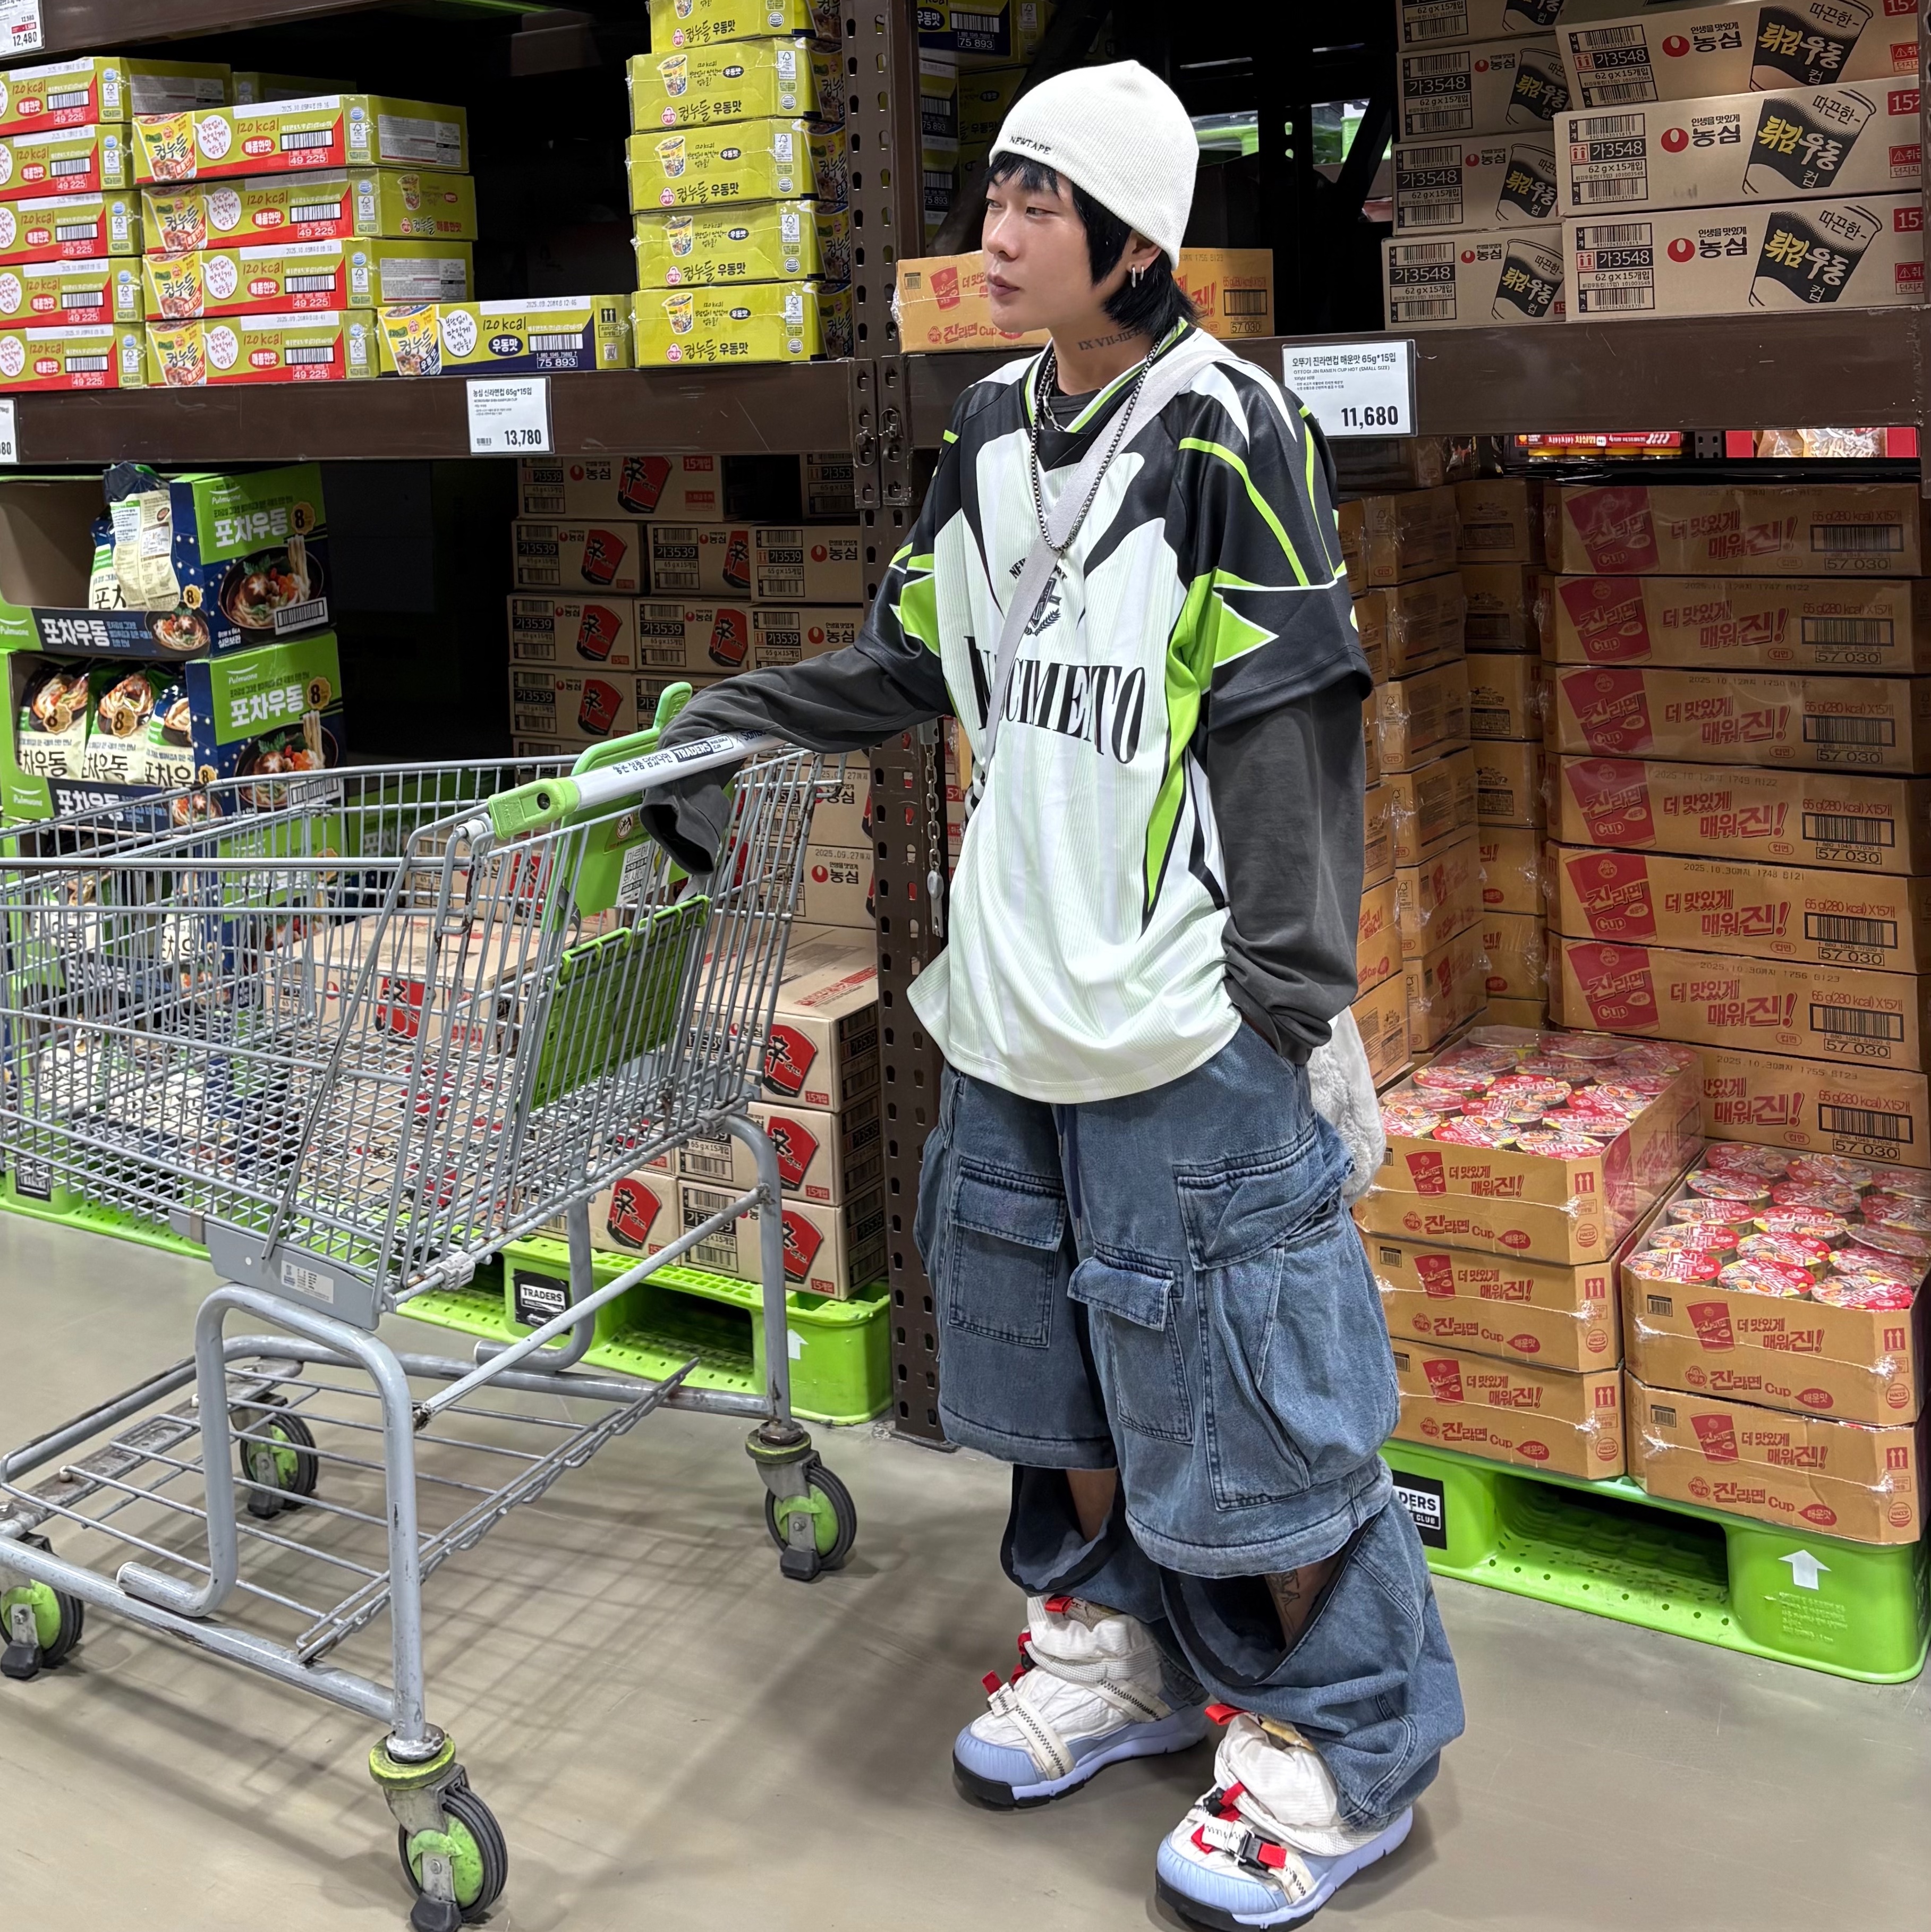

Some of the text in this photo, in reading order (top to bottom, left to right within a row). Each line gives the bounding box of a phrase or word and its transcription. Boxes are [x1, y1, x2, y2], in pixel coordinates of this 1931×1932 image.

[13, 31, 37, 46] 12,480
[959, 38, 993, 50] 75 893
[1692, 31, 1743, 53] 농심
[1595, 50, 1646, 66] 가3548
[678, 99, 742, 123] 컵누들 우동맛
[237, 123, 253, 134] 120
[256, 117, 279, 133] kcal
[1692, 124, 1741, 147] 농심
[1010, 135, 1052, 155] NEWTAPE
[1593, 140, 1643, 159] 가3548
[1481, 152, 1506, 165] 농심
[1402, 170, 1458, 188] 가3548
[1802, 171, 1819, 188] 컵
[1477, 248, 1502, 260] 농심
[1699, 237, 1749, 259] 농심
[243, 260, 283, 274] 120 kcal
[1598, 250, 1651, 267] 가3548
[683, 260, 746, 283] 컵누들 우동맛
[1395, 267, 1451, 283] 가3548
[482, 316, 526, 330] 120 kcal
[1231, 322, 1261, 333] 57 030
[943, 322, 997, 344] 진라면 Cup
[30, 342, 64, 354] 120 kcal
[398, 328, 433, 356] 컵누들
[492, 339, 518, 353] 우동맛
[684, 338, 749, 361] 컵누들 우동맛
[538, 357, 576, 368] 75 893
[1292, 356, 1312, 368] 오뚜기
[1313, 355, 1339, 367] 진라면컵
[1341, 354, 1361, 365] 매운맛
[484, 388, 505, 397] 신라면컵
[1341, 405, 1399, 429] 11,680
[505, 429, 542, 447] 13,780
[214, 507, 305, 548] 포차우동 8
[656, 546, 695, 559] 가3539
[770, 550, 802, 563] 가3539
[829, 545, 858, 560] 농심
[41, 618, 110, 648] 포차우동
[826, 628, 855, 643] 농심
[1700, 608, 1789, 649] 매워진!
[231, 683, 321, 729] 포차우동 8
[115, 711, 124, 731] 8
[674, 742, 712, 759] TRADERS
[1585, 785, 1643, 820] 진라면
[1663, 790, 1732, 816] 더 맛있게
[1595, 821, 1625, 836] Cup
[1699, 801, 1789, 839] 매워진!
[1818, 848, 1880, 864] 57 030
[830, 869, 859, 884] 농심
[1702, 901, 1791, 937] 매워진!
[1821, 949, 1882, 966] 57 030
[1587, 972, 1645, 1002] 진라면
[1670, 979, 1740, 1001] 더 맛있게
[1598, 1003, 1628, 1019] Cup
[1707, 991, 1797, 1028] 매워진!
[1826, 1041, 1889, 1058] 57 030
[1714, 1092, 1805, 1126] 매워진!
[1449, 1165, 1491, 1180] 더 맛있게
[1471, 1174, 1525, 1197] 매워진!
[1424, 1215, 1526, 1244] 진라면 Cup 매운맛
[523, 1287, 563, 1302] TRADERS
[1737, 1317, 1785, 1332] 더 맛있게
[1763, 1328, 1825, 1353] 매워진!
[1710, 1369, 1828, 1404] 진라면 Cup 매운맛
[1398, 1491, 1436, 1511] DERS
[1713, 1483, 1832, 1521] 진라면 Cup 매운맛
[1416, 1514, 1435, 1525] CLUB
